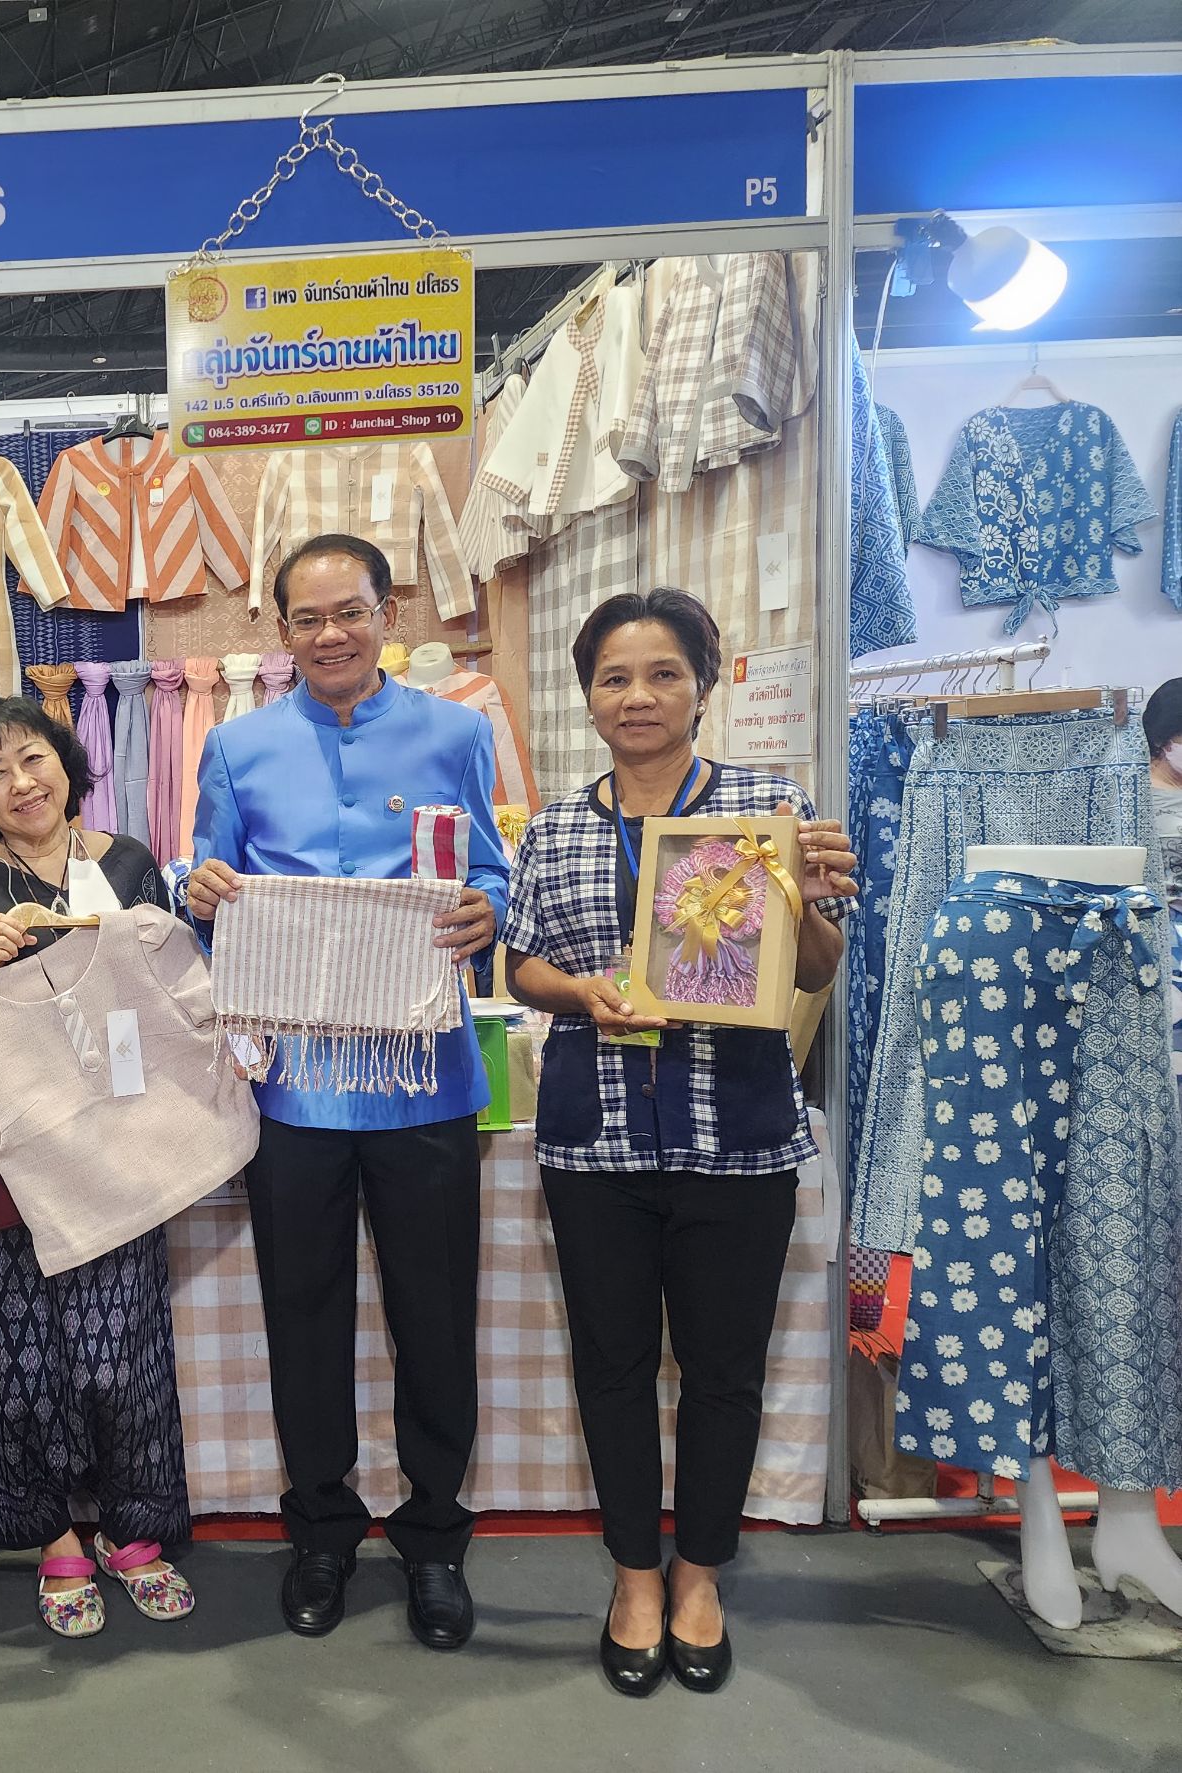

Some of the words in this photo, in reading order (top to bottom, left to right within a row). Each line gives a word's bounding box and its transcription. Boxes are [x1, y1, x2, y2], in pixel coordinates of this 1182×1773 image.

[745, 177, 778, 207] P5
[273, 289, 297, 305] เพจ
[304, 275, 409, 303] จันทร์ฉายผ้าไทย
[415, 273, 459, 295] ยโสธร
[184, 399, 209, 412] 142
[214, 398, 234, 410] ม.5
[240, 391, 291, 409] ต.ศรีแก้ว
[364, 384, 412, 400] จ.ยโสธร
[418, 383, 460, 396] 35120
[208, 422, 291, 439] 084-389-3477
[325, 420, 338, 431] ID
[350, 413, 431, 430] Janchai_Shop
[436, 413, 457, 424] 101
